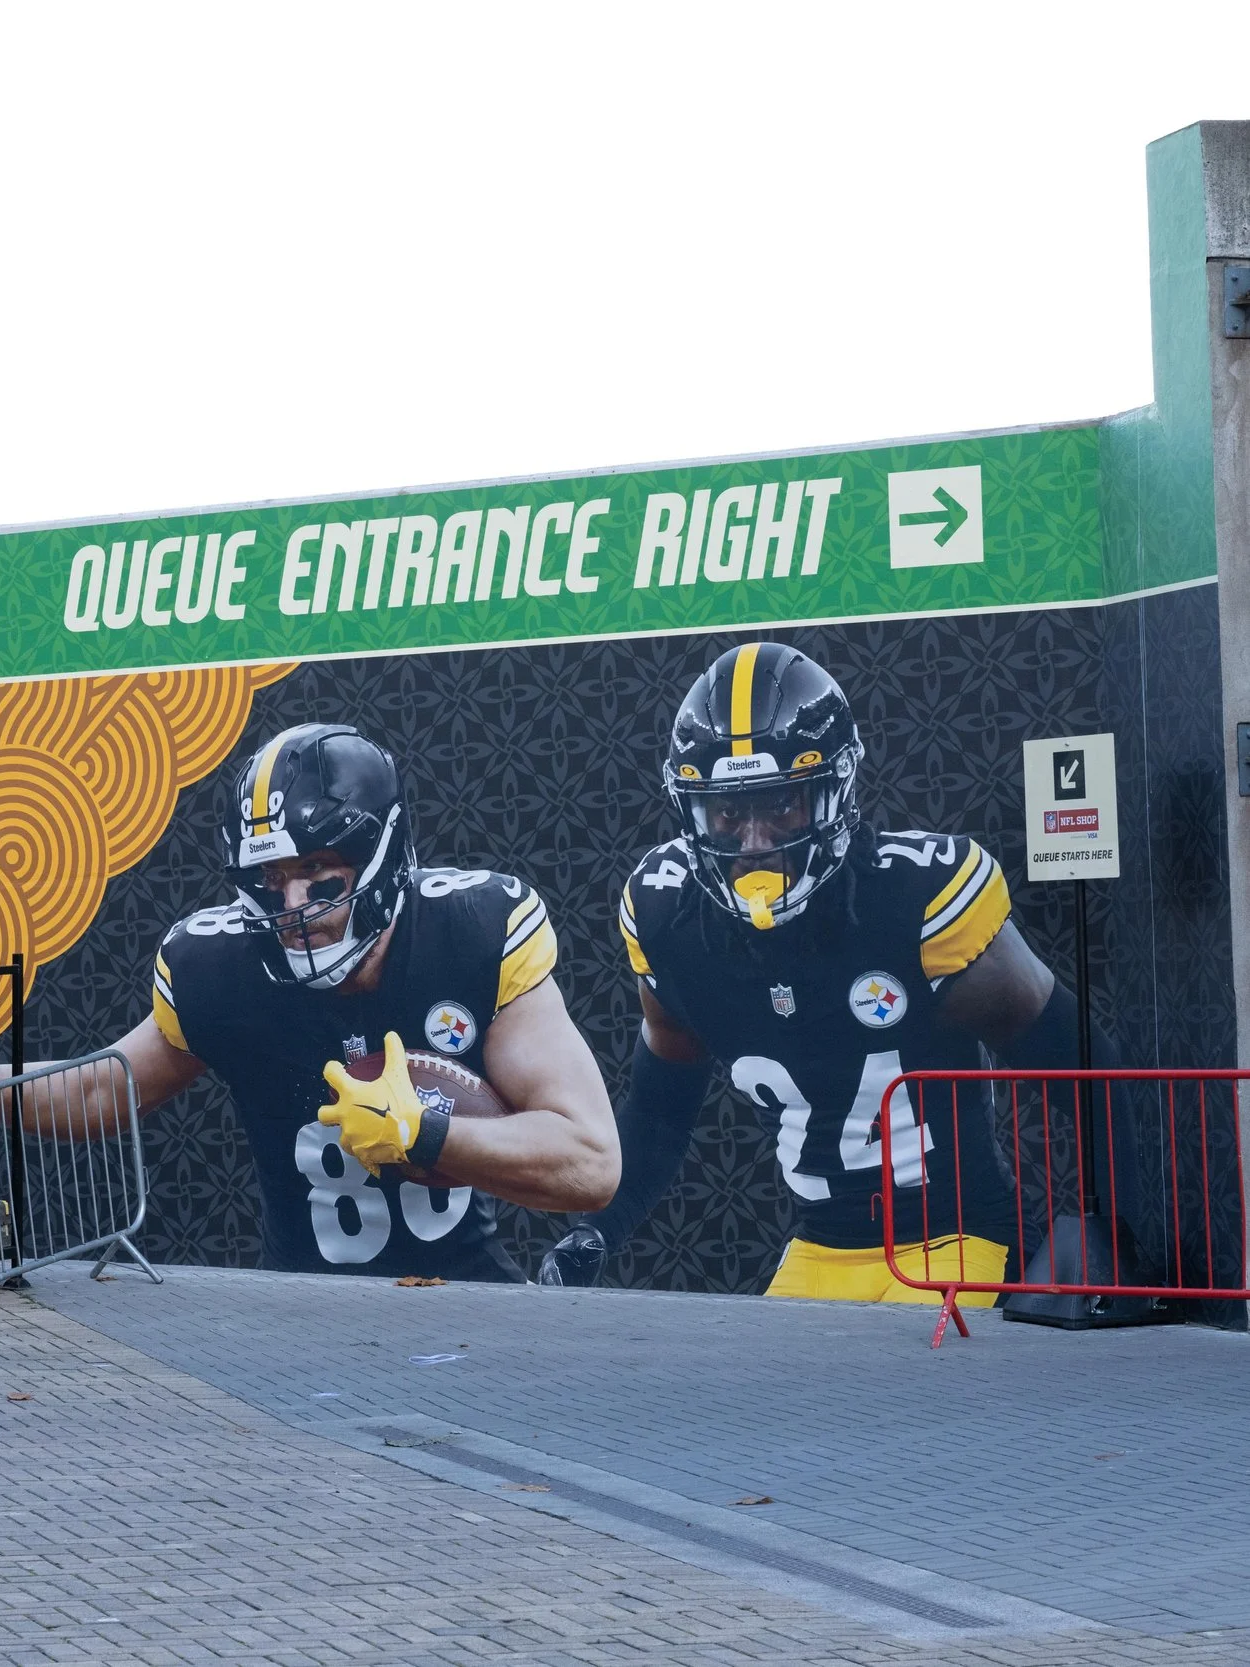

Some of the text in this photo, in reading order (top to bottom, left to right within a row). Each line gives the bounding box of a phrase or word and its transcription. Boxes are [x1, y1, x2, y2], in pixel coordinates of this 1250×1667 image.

[63, 477, 843, 633] QUEUE ENTRANCE RIGHT
[727, 759, 762, 772] Steelers
[249, 840, 277, 855] Steelers
[1033, 849, 1113, 863] QUEUE STARTS HERE
[730, 1050, 935, 1200] 24
